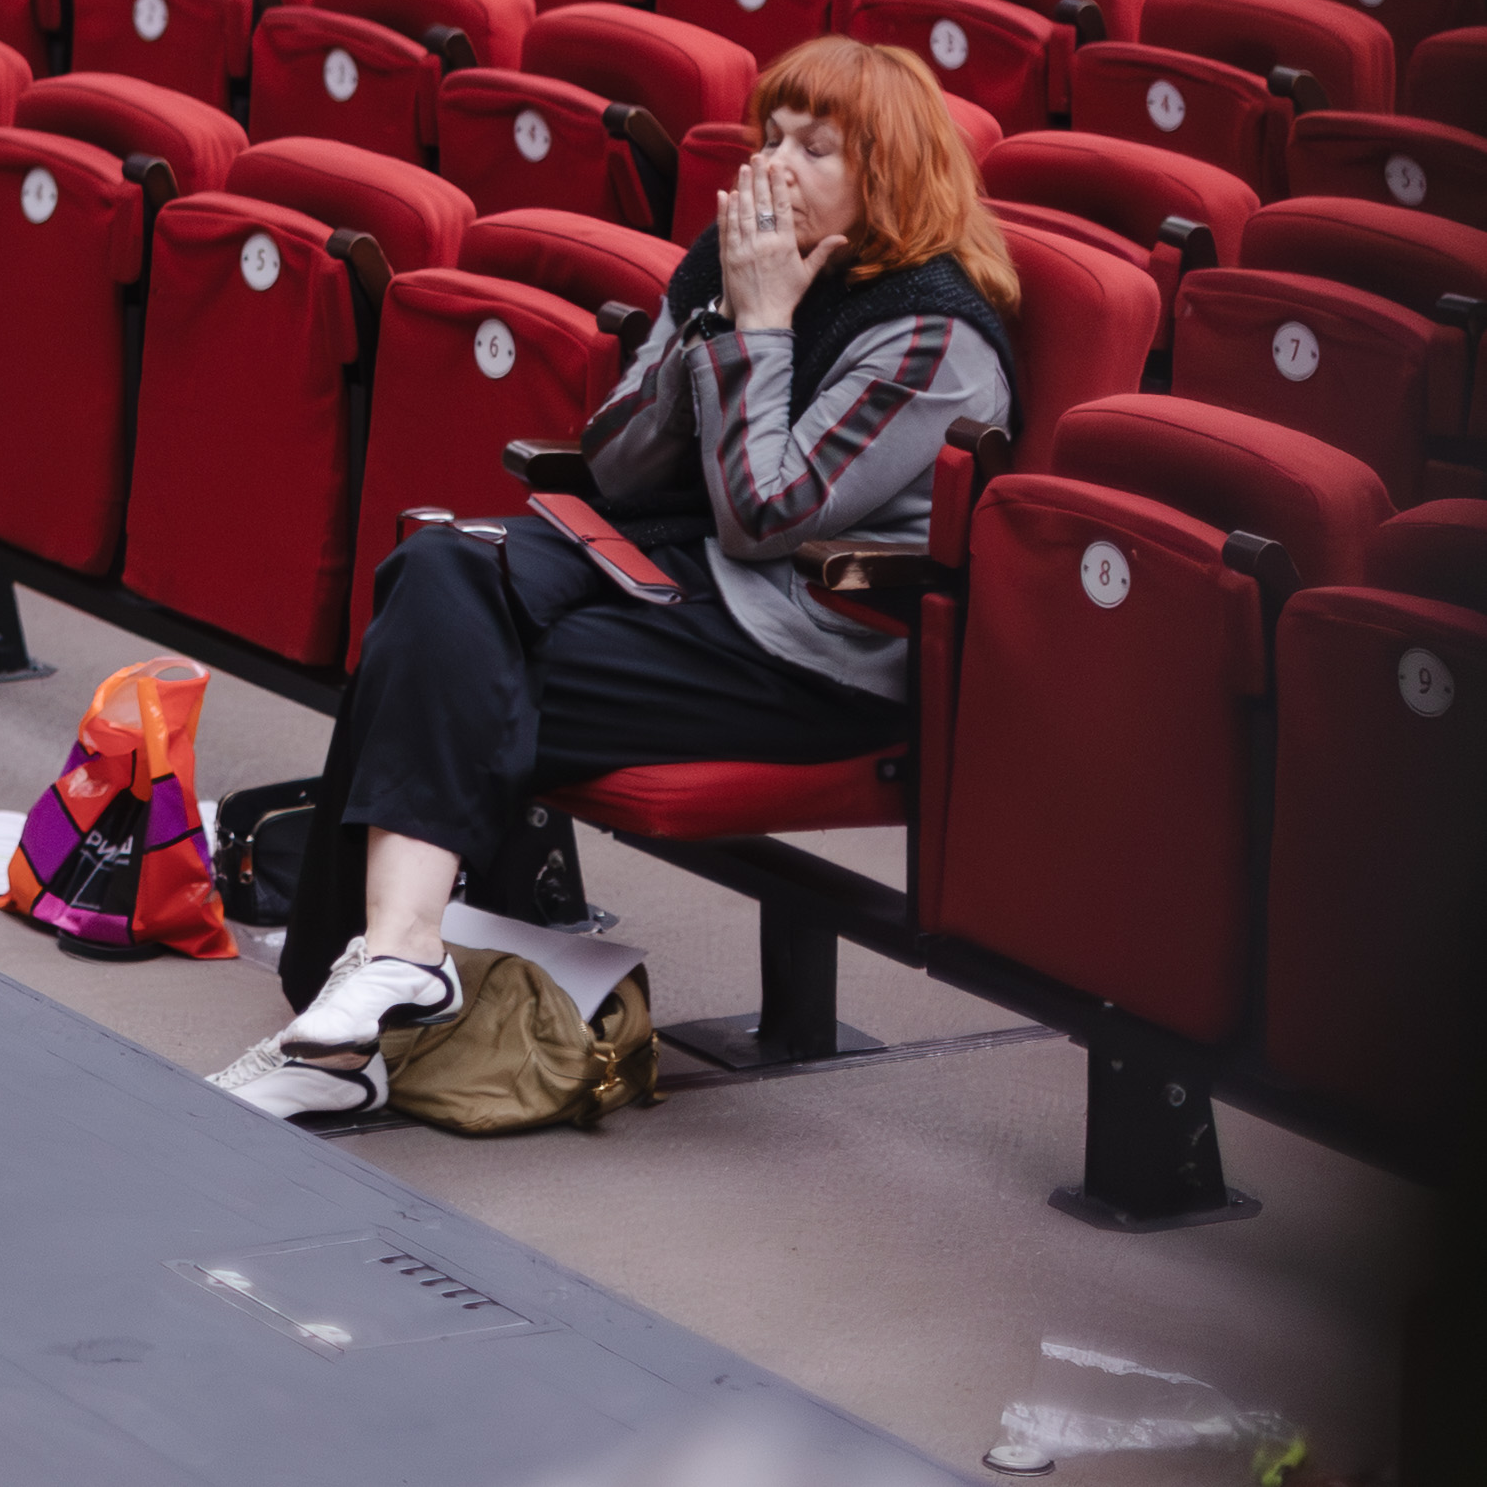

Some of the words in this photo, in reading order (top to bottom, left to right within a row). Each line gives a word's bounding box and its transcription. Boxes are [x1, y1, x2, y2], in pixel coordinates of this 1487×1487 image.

[257, 248, 266, 271] 5
[489, 335, 499, 358] 6
[1290, 338, 1301, 362] 7
[1099, 559, 1111, 586] 8
[1419, 667, 1432, 694] 9
